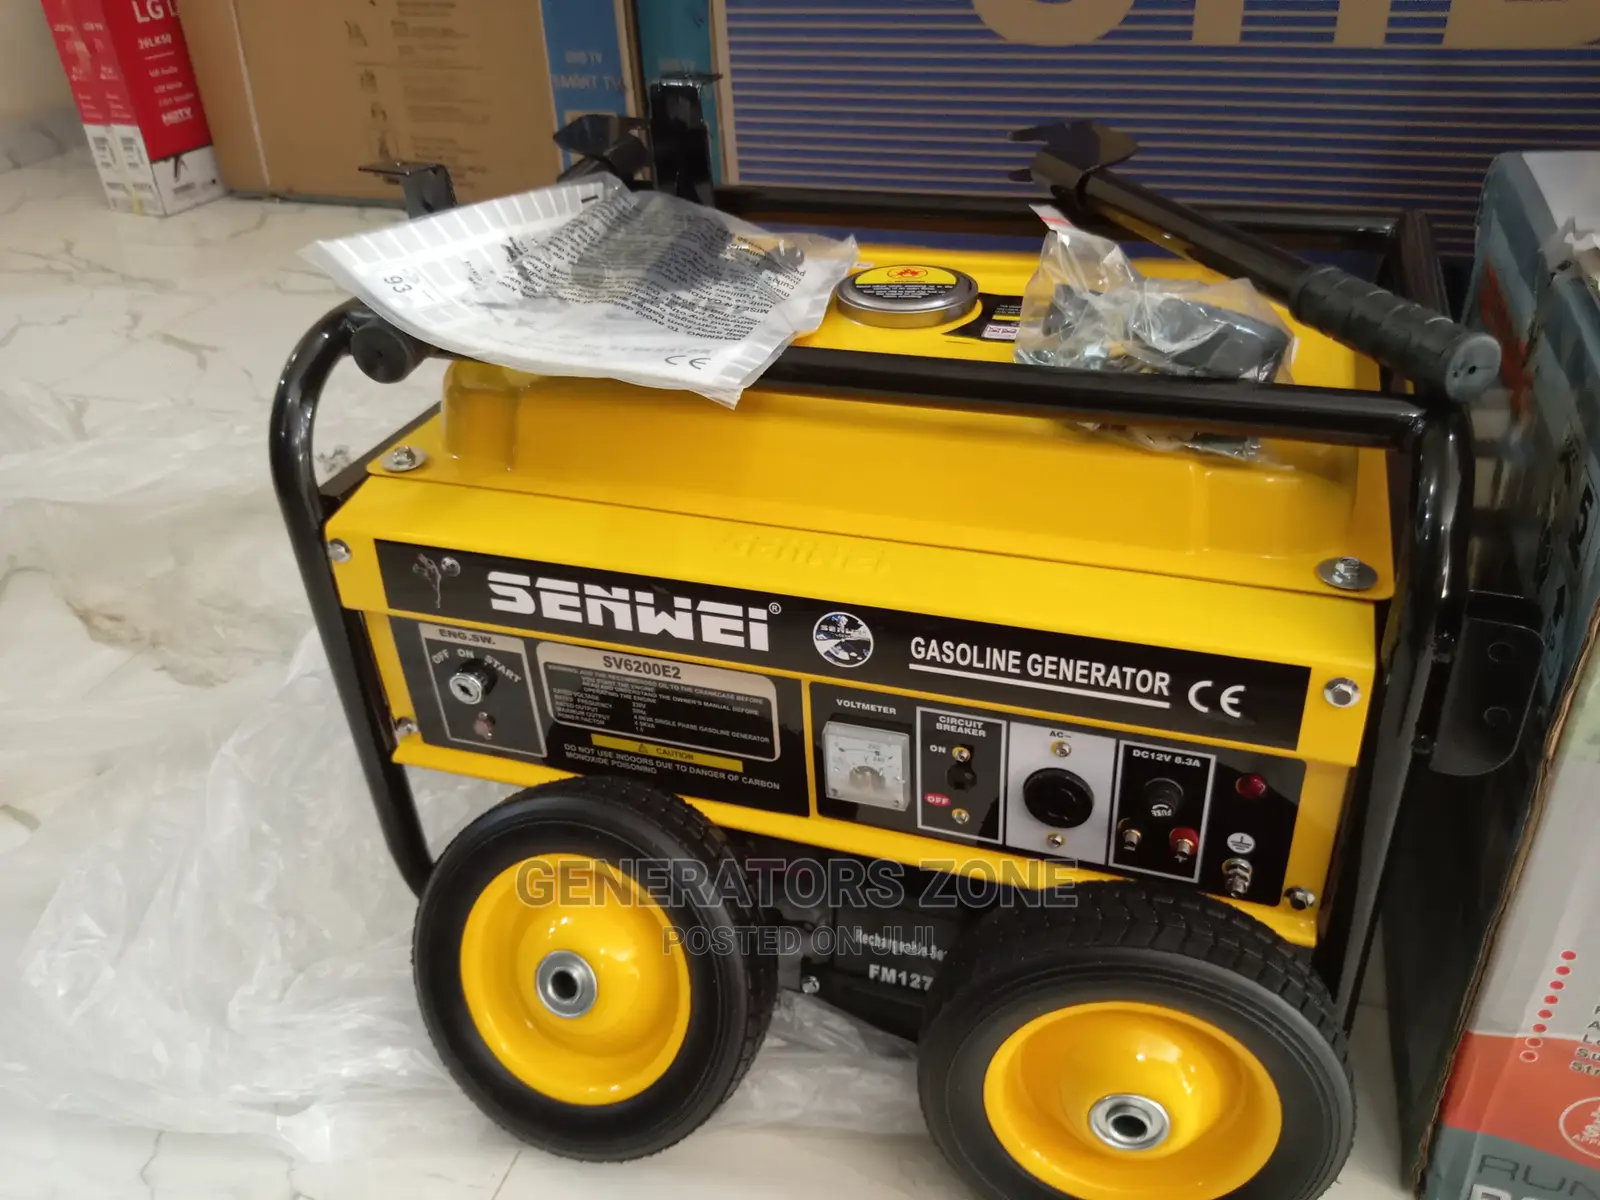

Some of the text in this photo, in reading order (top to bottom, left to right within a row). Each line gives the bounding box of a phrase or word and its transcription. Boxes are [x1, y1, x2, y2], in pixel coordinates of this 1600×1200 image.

[132, 0, 164, 23] LG
[487, 571, 769, 652] SENWEI
[431, 648, 522, 683] OFF ON START
[602, 655, 682, 680] SV6200E2
[910, 635, 1246, 720] GASOLINE GENERATOR CE
[633, 695, 657, 704] ENGINE
[658, 693, 671, 701] THE
[703, 701, 731, 712] MANUAL
[732, 706, 760, 716] BEFORE
[680, 686, 694, 694] THE
[694, 687, 736, 700] CRANKCASE
[735, 694, 763, 705] BEFORE
[835, 698, 898, 716] VOLTMETER
[677, 720, 699, 731] PHASE
[699, 725, 731, 737] GASOLINE
[731, 731, 771, 743] GENERATOR
[935, 722, 987, 738] BREAKER
[938, 715, 985, 730] CIRCUIT
[656, 747, 694, 761] CAUTION
[929, 744, 947, 754] ON
[1132, 749, 1201, 768] DC12V 8.3A
[563, 743, 780, 791] DO NOT USE INDOORS DUE TO DANGER OF CARBON
[565, 751, 658, 774] MONOXIDE POISONING
[926, 795, 950, 806] OFF
[868, 963, 934, 992] FM127
